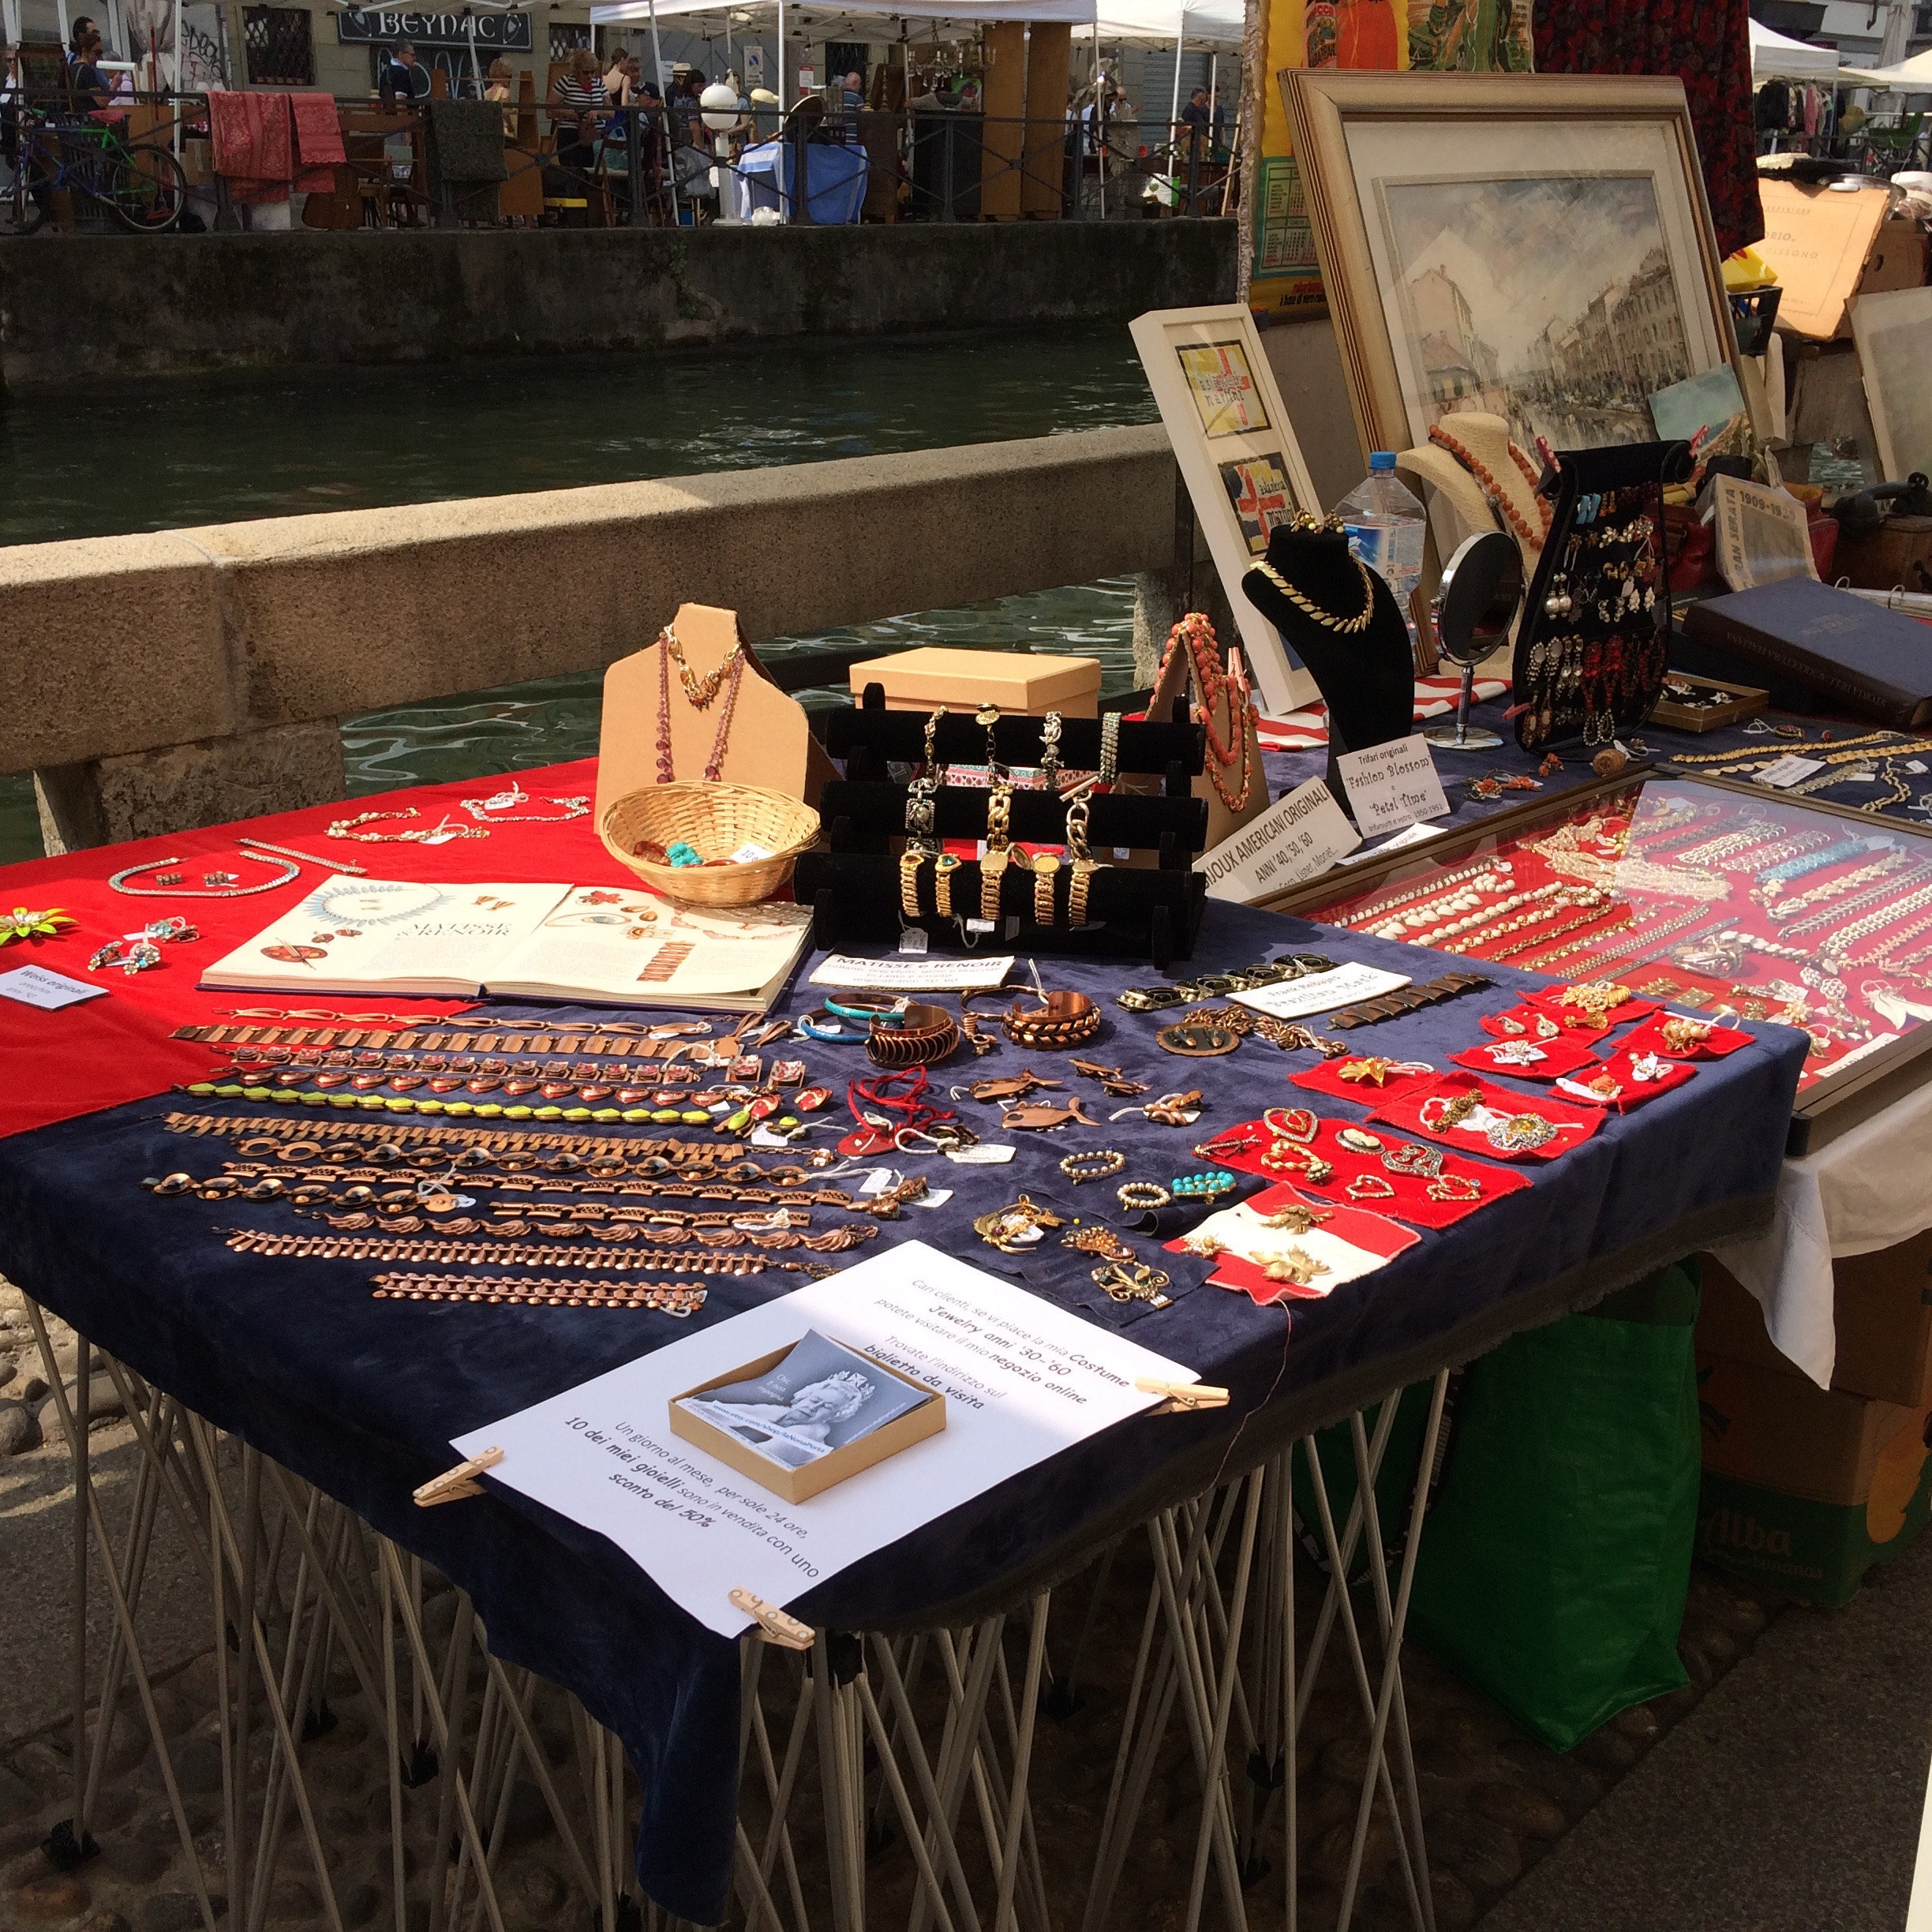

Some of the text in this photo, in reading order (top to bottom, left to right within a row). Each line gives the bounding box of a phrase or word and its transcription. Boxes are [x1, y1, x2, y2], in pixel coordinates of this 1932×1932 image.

[379, 12, 496, 37] BEYNAC
[1357, 743, 1409, 766] Trifari originali
[1235, 814, 1289, 863] AMERICANI
[1282, 784, 1331, 826] ORIGINALI
[1255, 859, 1278, 884] ANNI
[1299, 831, 1313, 848] '60
[837, 957, 915, 968] MATISSE
[874, 1298, 915, 1320] potete
[915, 1318, 956, 1340] visitare
[964, 1342, 990, 1356] mio
[988, 1354, 1042, 1383] negozio
[1044, 1382, 1088, 1405] online
[929, 1305, 983, 1334] Jewelry
[984, 1333, 1017, 1349] anni
[934, 1290, 969, 1312] clienti,
[972, 1306, 987, 1317] se
[996, 1320, 1032, 1340] piace
[1032, 1335, 1044, 1346] la
[1044, 1342, 1069, 1357] mia
[1069, 1354, 1130, 1388] Costume
[863, 1343, 986, 1410] biglietto da visita
[886, 1335, 1007, 1398] Trovate l'indirizzo sul
[565, 1417, 820, 1578] 10 dei miei gioielli sono in vendita con uno
[608, 1472, 717, 1529] sconto del 50%
[615, 1421, 808, 1539] Un giorno al mese, per sole 24 ore,
